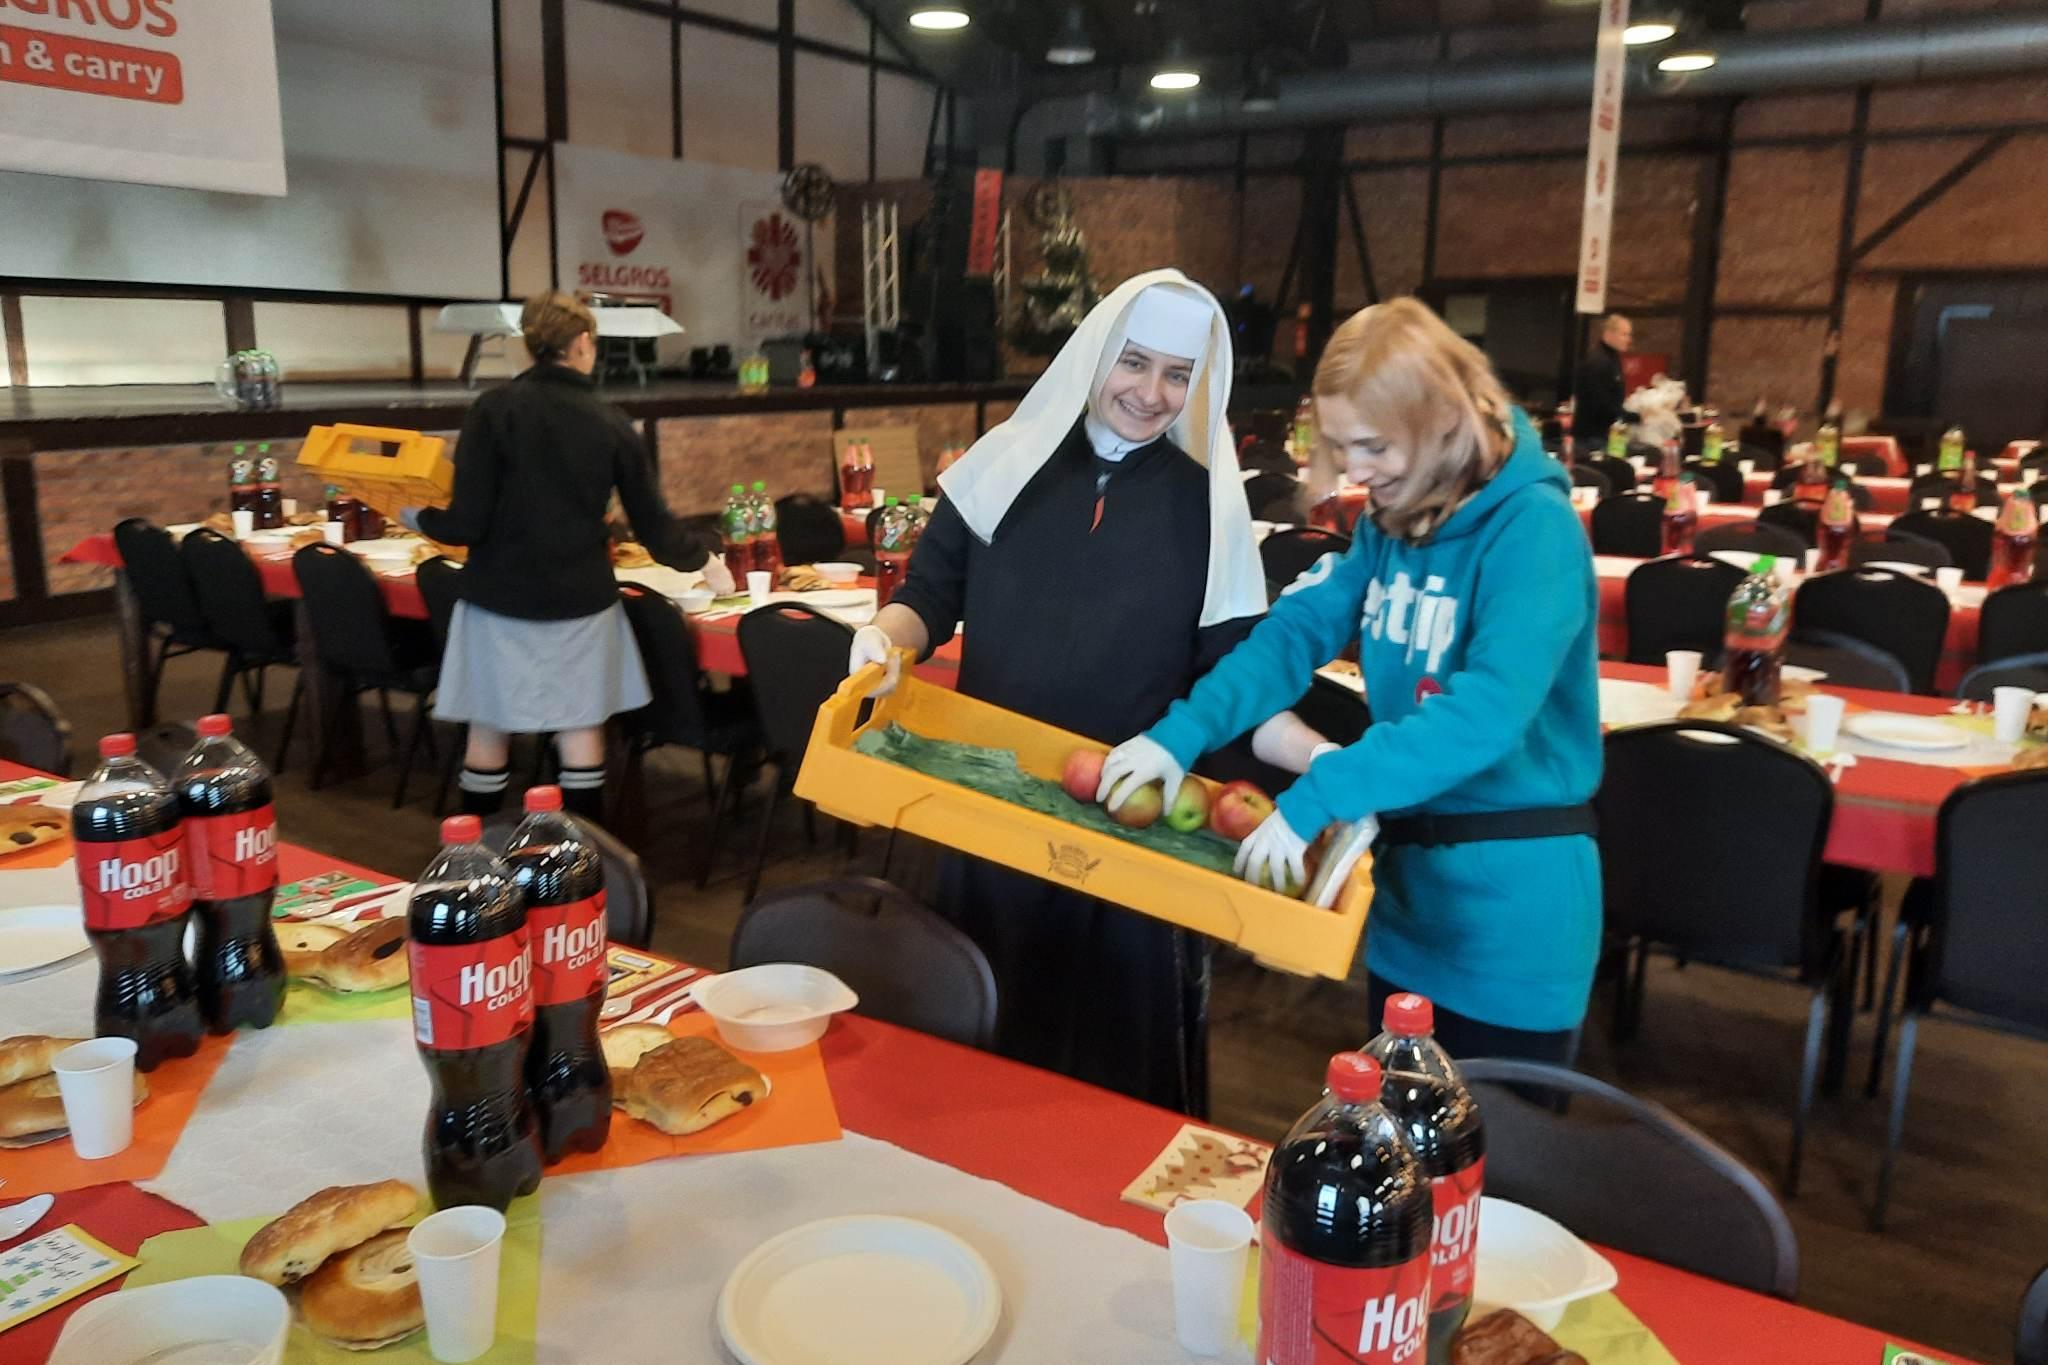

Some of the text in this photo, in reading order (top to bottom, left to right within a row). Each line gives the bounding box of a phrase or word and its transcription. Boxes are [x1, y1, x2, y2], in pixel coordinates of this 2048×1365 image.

[24, 40, 55, 72] &
[64, 53, 164, 95] carry
[579, 263, 670, 289] SELGROS
[99, 848, 180, 893] Hoop
